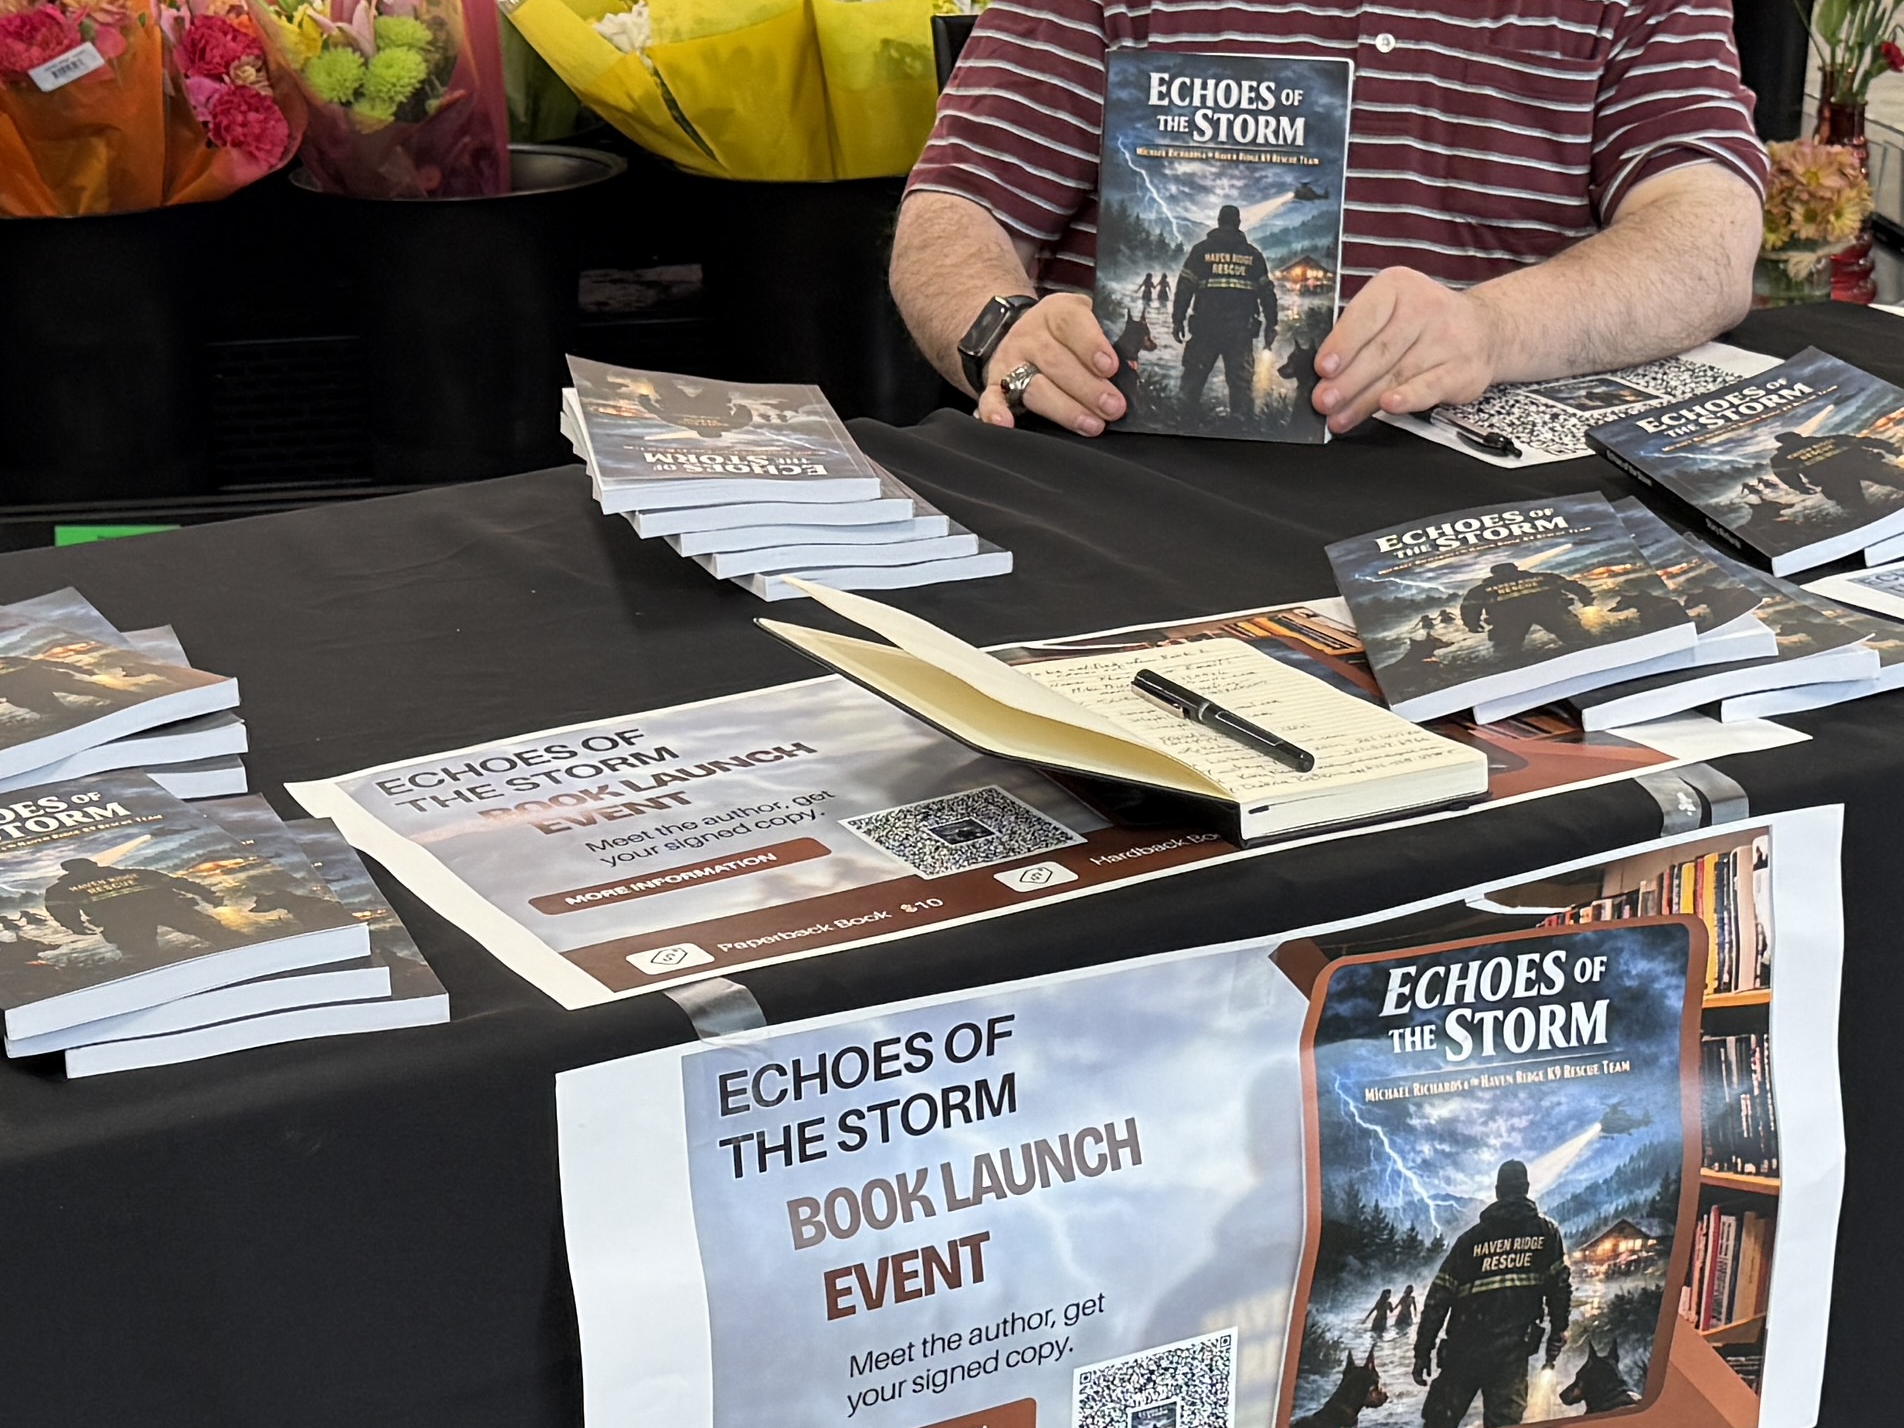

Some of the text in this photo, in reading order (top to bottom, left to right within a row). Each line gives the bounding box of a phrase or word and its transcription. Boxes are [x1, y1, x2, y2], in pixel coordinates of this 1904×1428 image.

[1148, 72, 1304, 111] ECHOES OF
[1157, 109, 1306, 146] THE STORM
[1635, 376, 1789, 435] ECHOES OF
[1663, 382, 1814, 439] THE STORM
[1374, 507, 1555, 554] ECHOES OF
[1393, 516, 1569, 559] THE STORM
[375, 728, 647, 797] ECHOES OF
[394, 745, 680, 813] THE STORM
[478, 741, 819, 822] BOOK LAUNCH
[71, 791, 102, 805] OF
[527, 790, 695, 836] EVENT
[585, 788, 836, 854] Meet the author, get
[599, 809, 826, 869] your signed copy.
[564, 852, 777, 908] MORE INFORMATION
[717, 897, 945, 955] Paperback Book $10
[1378, 950, 1608, 1018] ECHOES OF
[1388, 998, 1611, 1063] THE STORM
[718, 1013, 1016, 1117] ECHOES OF
[718, 1072, 1018, 1179] THE STORM
[786, 1117, 1143, 1251] BOOK LAUNCH
[823, 1230, 991, 1322] EVENT
[1473, 1236, 1545, 1258] HAVEN RIDGE
[1482, 1252, 1533, 1272] RESCUE
[849, 1292, 1106, 1378] Meet the author, get
[847, 1335, 1074, 1417] your signed copy.
